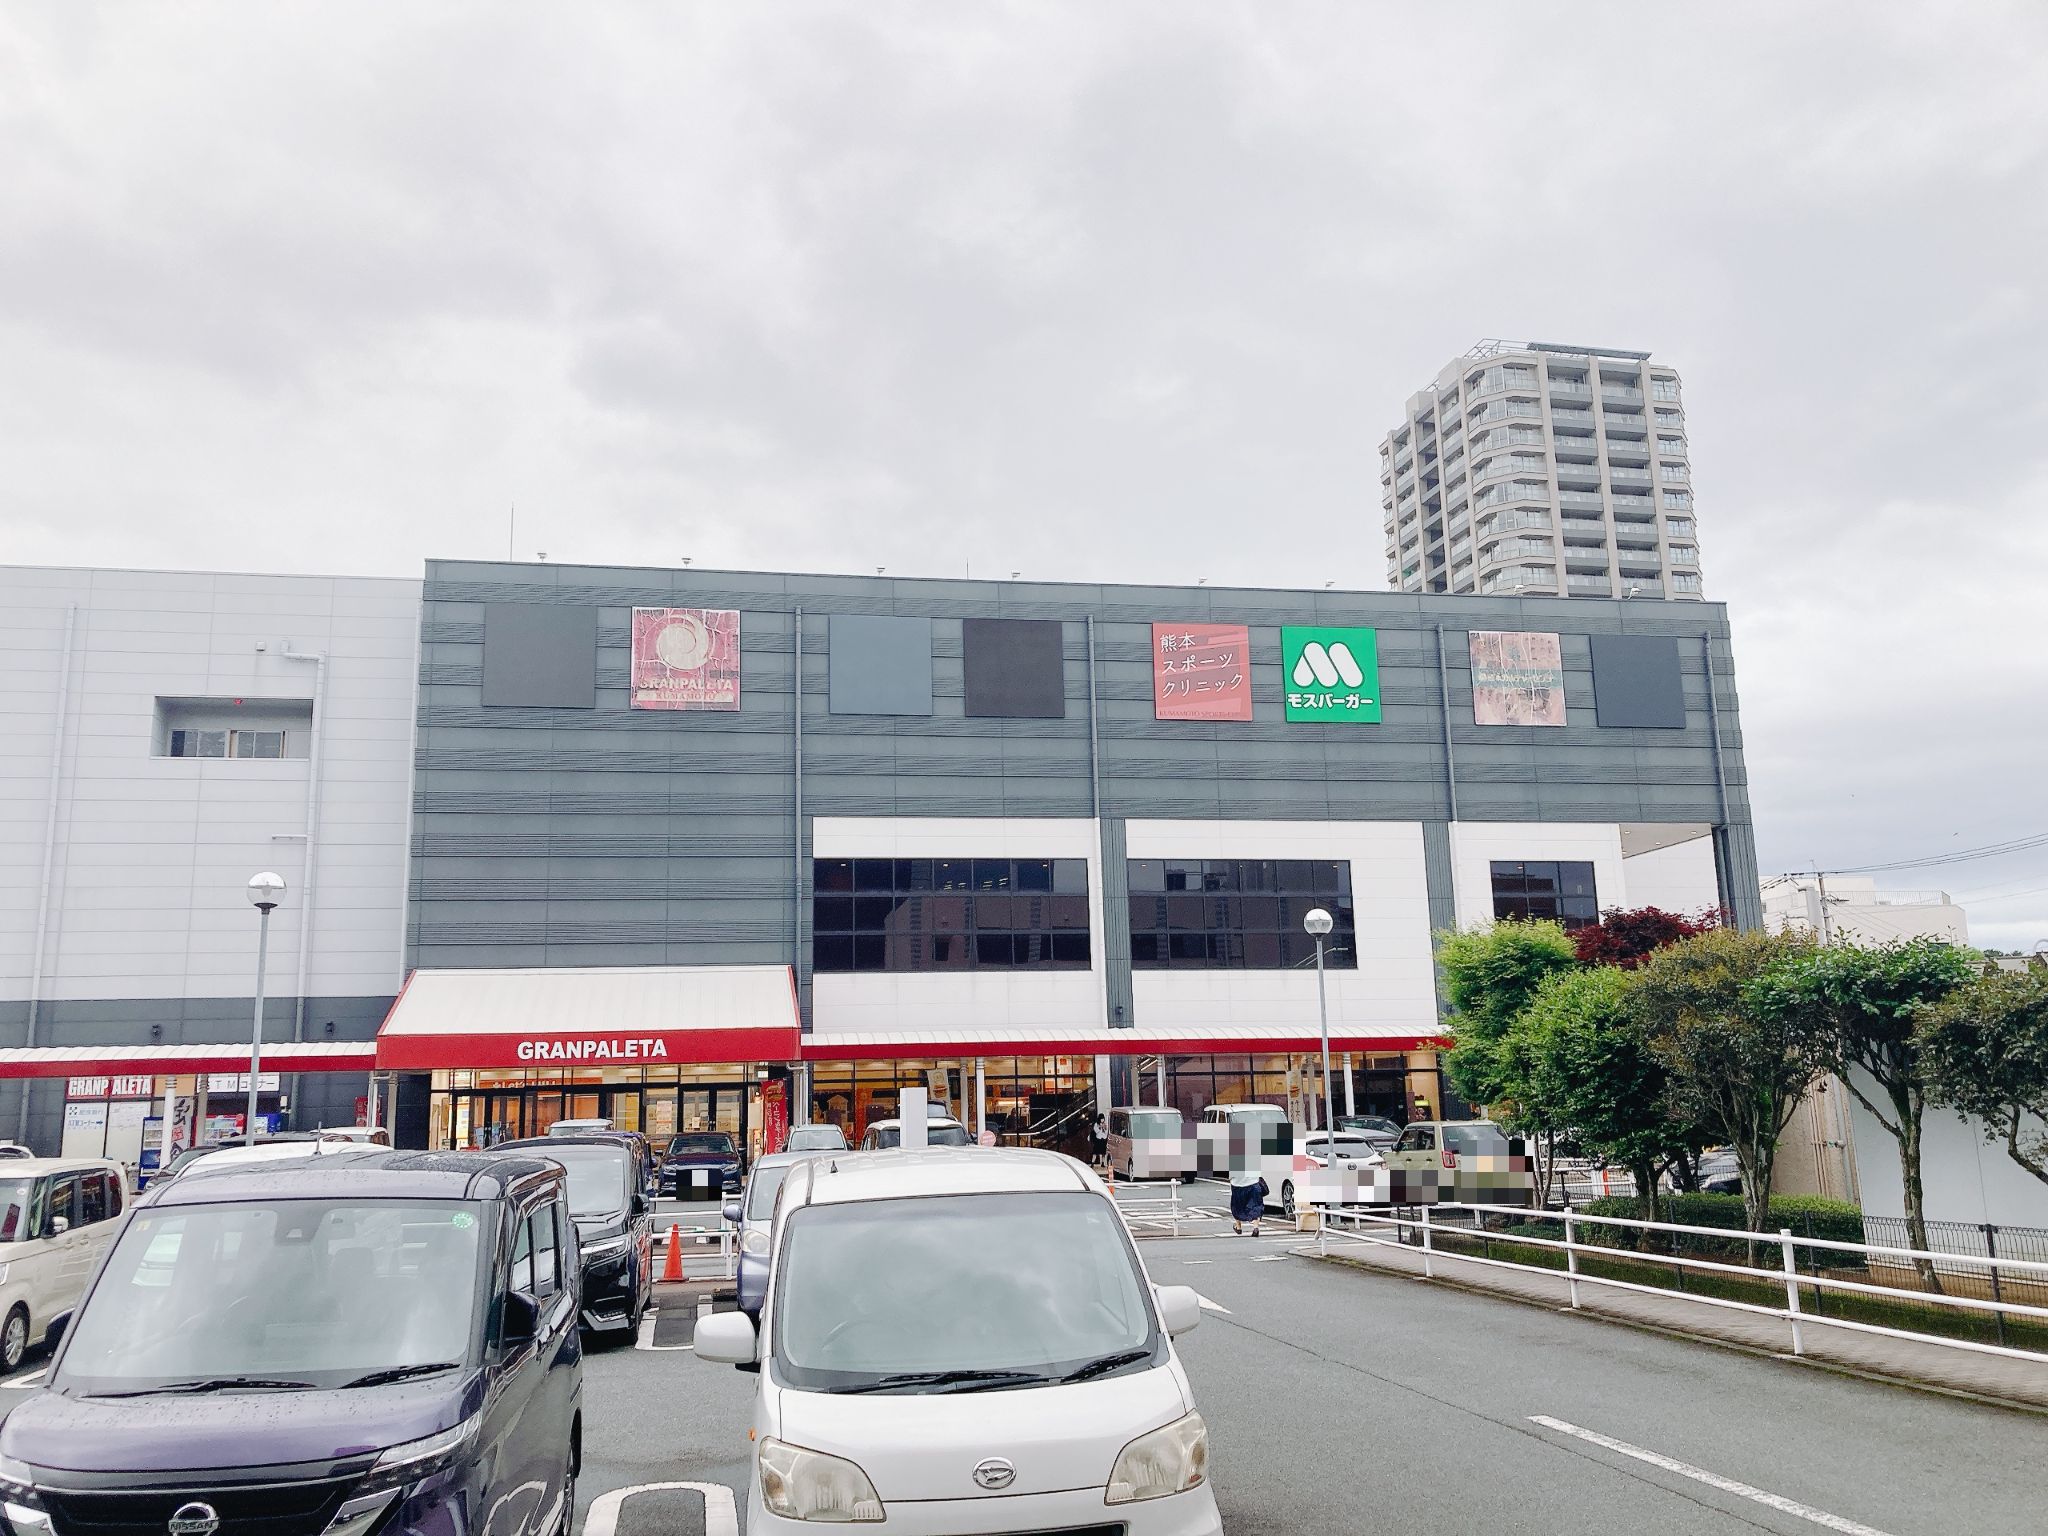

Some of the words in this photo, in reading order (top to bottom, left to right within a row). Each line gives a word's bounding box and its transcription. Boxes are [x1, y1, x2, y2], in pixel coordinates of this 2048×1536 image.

[1160, 632, 1196, 653] 熊本
[1162, 653, 1233, 675] スポーツ
[1162, 673, 1243, 699] クリニック
[1288, 693, 1374, 709] モスバーガー
[517, 1039, 668, 1060] GRANPALETA
[170, 1521, 213, 1531] NISSAN
